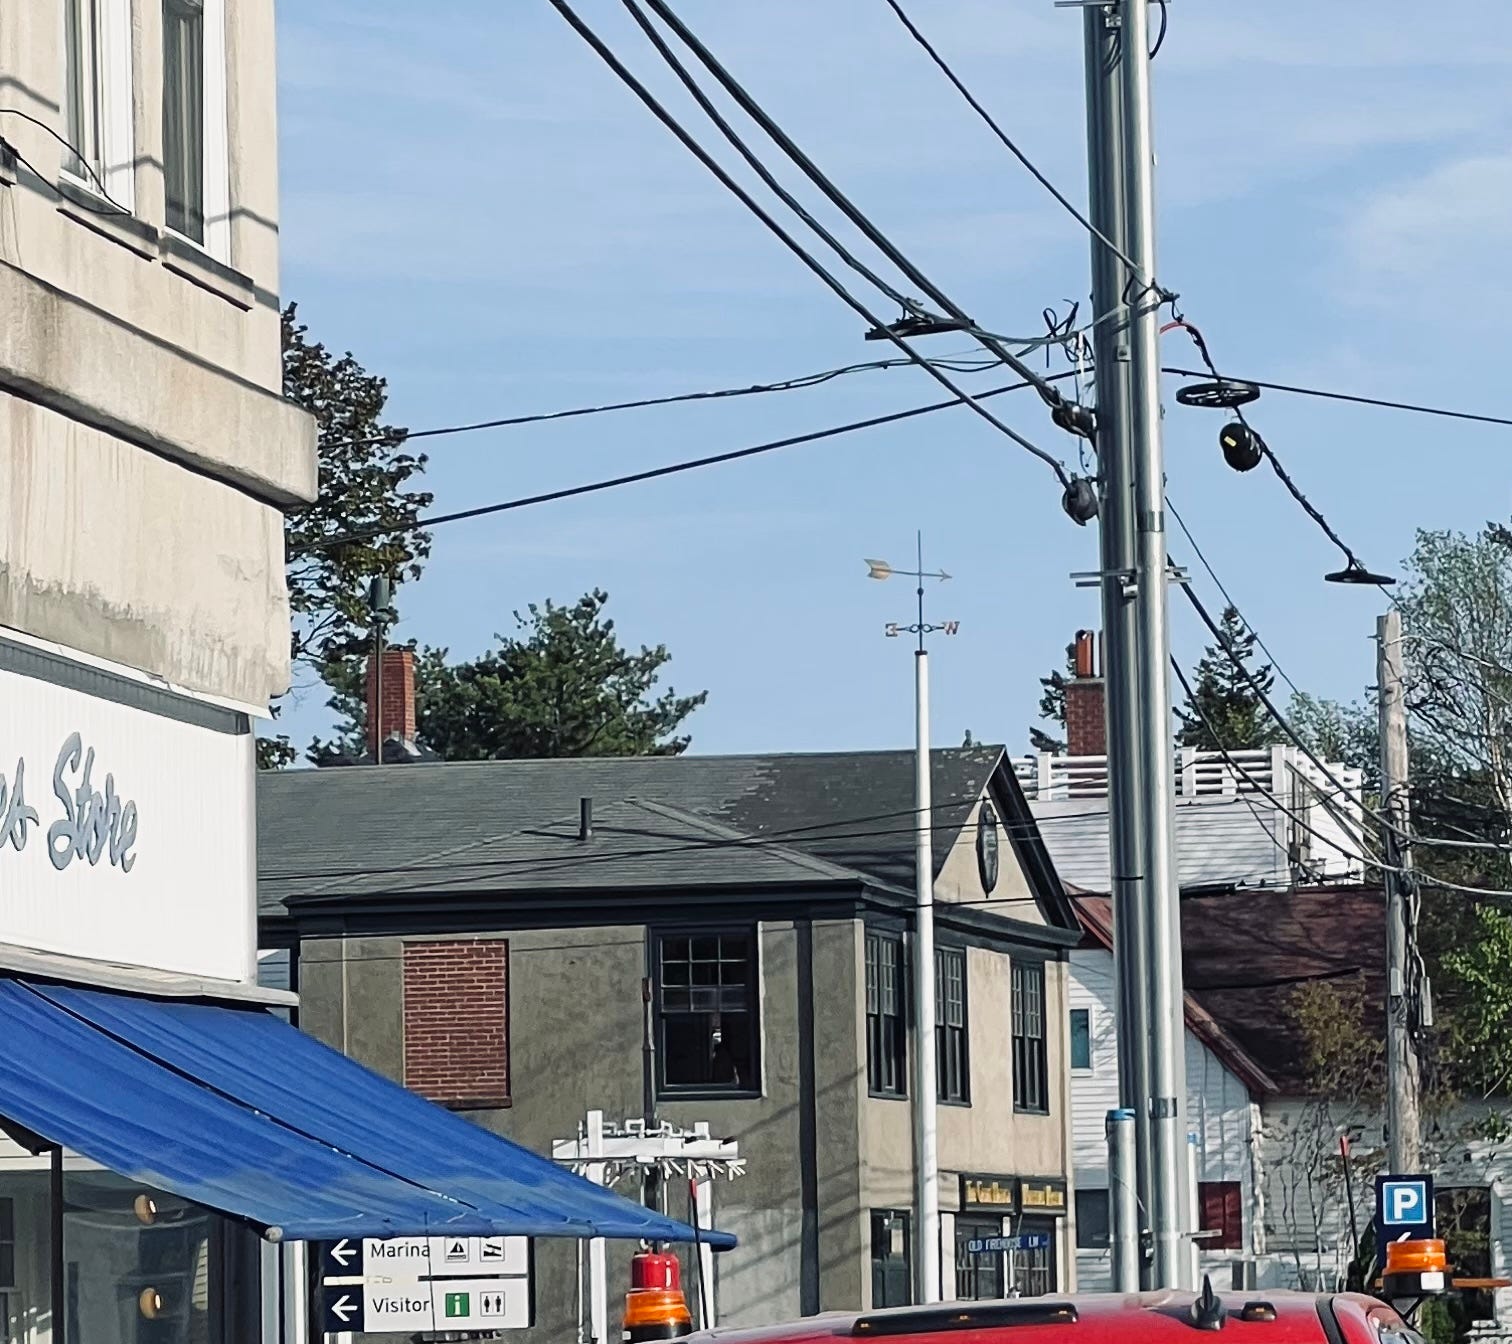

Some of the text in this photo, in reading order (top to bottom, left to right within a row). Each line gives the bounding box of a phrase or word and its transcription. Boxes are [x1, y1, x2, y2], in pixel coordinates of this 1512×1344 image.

[47, 731, 138, 873] Store
[1393, 1187, 1419, 1220] P
[371, 1241, 430, 1258] Marina
[968, 1239, 983, 1252] OLD
[372, 1298, 430, 1314] Visitor
